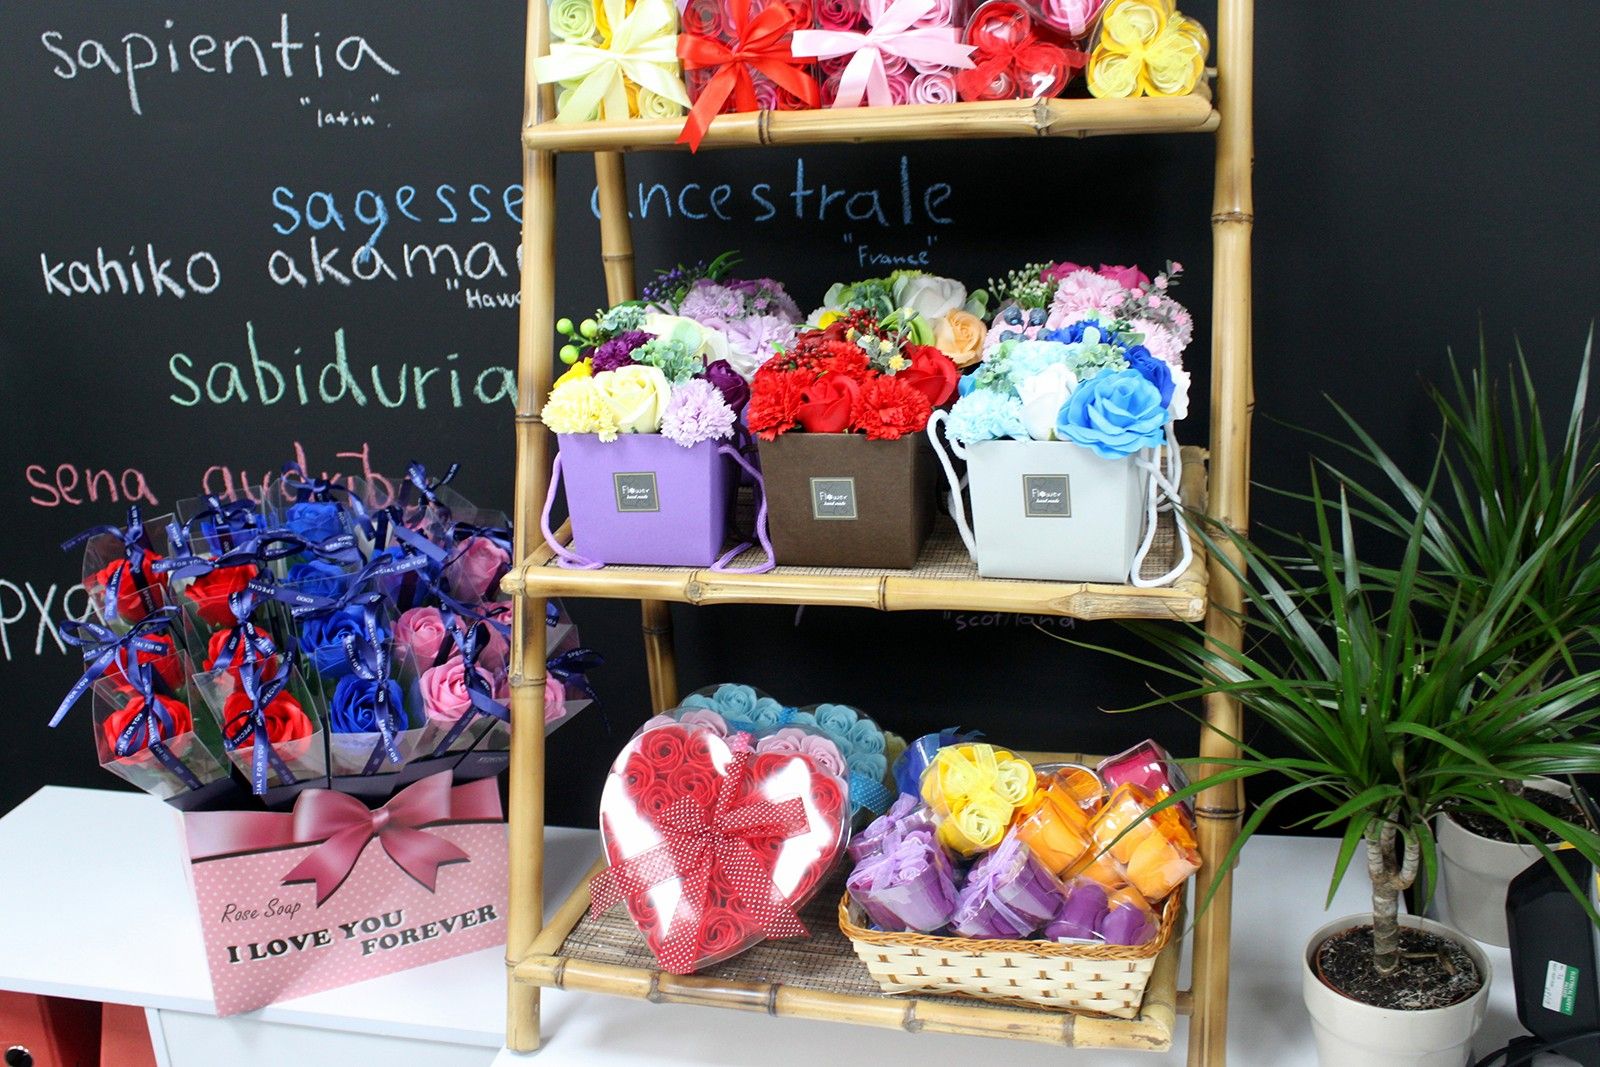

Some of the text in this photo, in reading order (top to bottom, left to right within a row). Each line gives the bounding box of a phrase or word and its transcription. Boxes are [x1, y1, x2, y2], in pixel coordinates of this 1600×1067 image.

[41, 13, 401, 117] sapientia
[272, 184, 524, 263] sagesse
[41, 244, 221, 299] kahiko
[25, 463, 159, 506] sena
[255, 760, 264, 778] FOR
[257, 743, 266, 760] YOU
[221, 898, 302, 923] Rose Soap
[226, 908, 405, 964] I LOVE YOU
[360, 903, 499, 957] FOREVER
